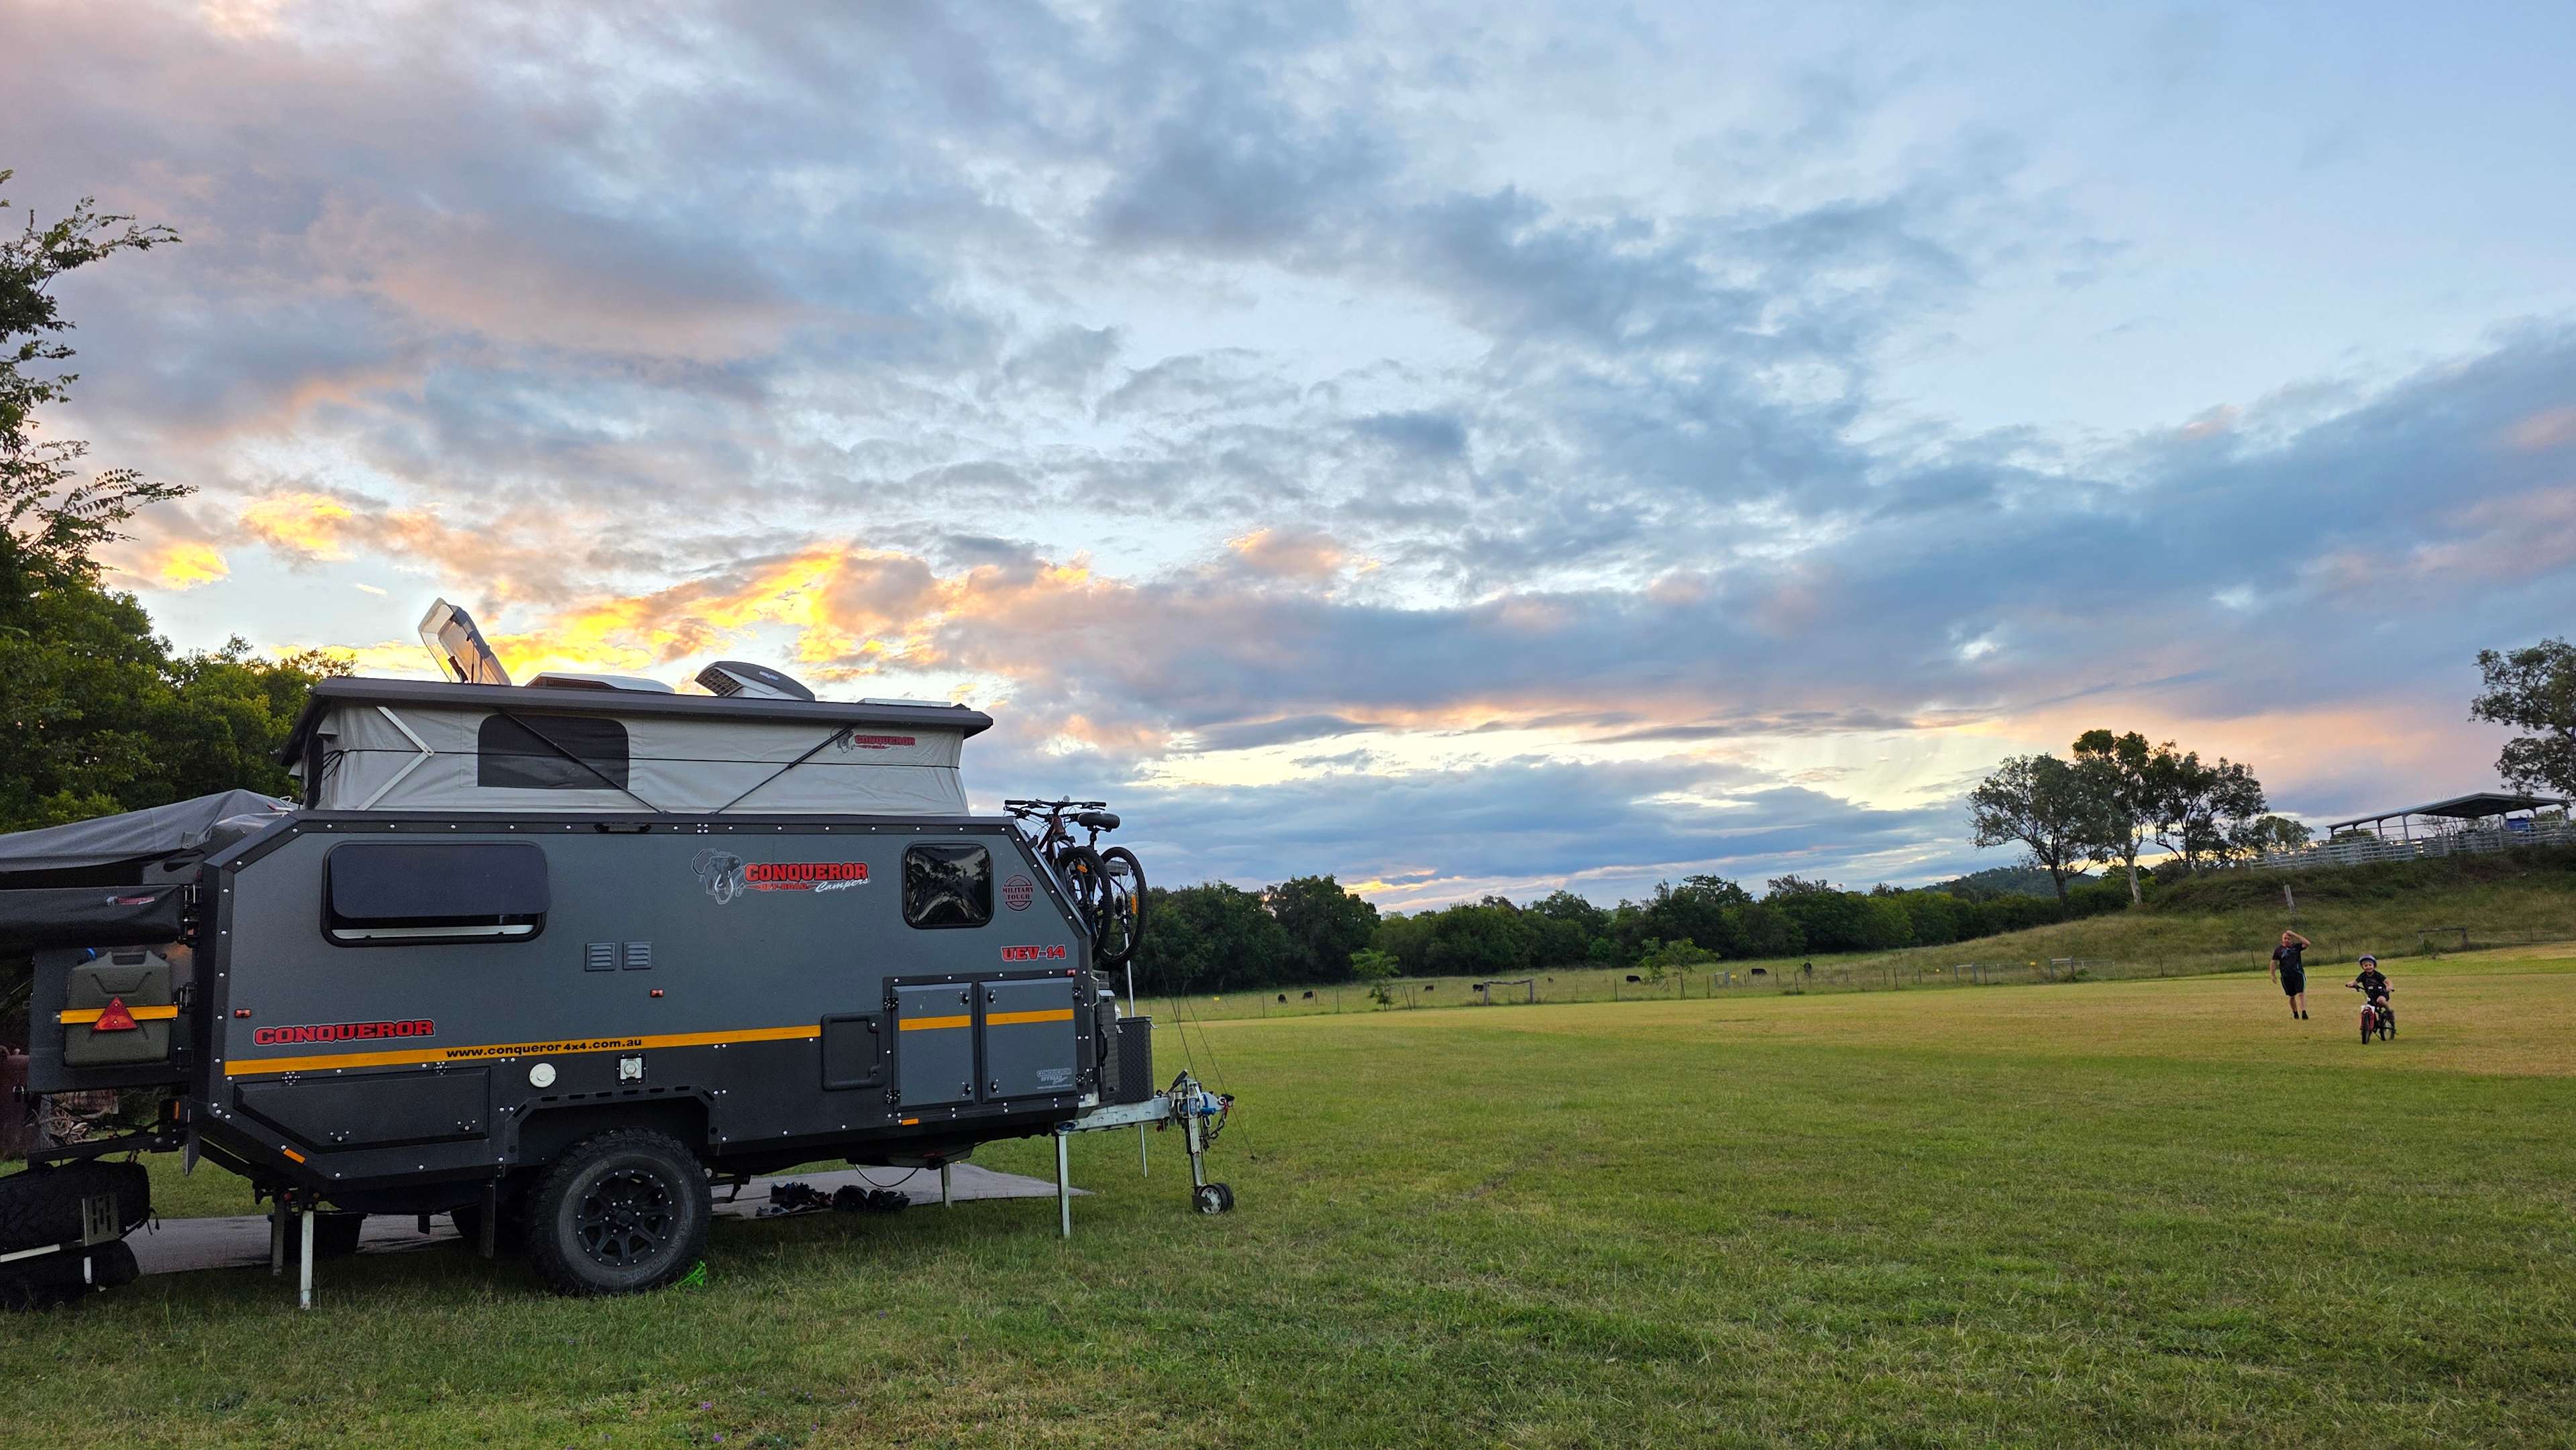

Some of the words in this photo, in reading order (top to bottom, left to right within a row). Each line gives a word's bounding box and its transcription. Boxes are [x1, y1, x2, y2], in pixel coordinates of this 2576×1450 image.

[855, 734, 916, 746] CONQUEROR
[745, 863, 868, 882] CONQUEROR
[816, 878, 868, 892] Campers
[1001, 944, 1066, 961] UEV-14
[254, 1019, 435, 1046] CONQUEROR
[447, 1040, 641, 1057] www.conqueror4x4.com.au
